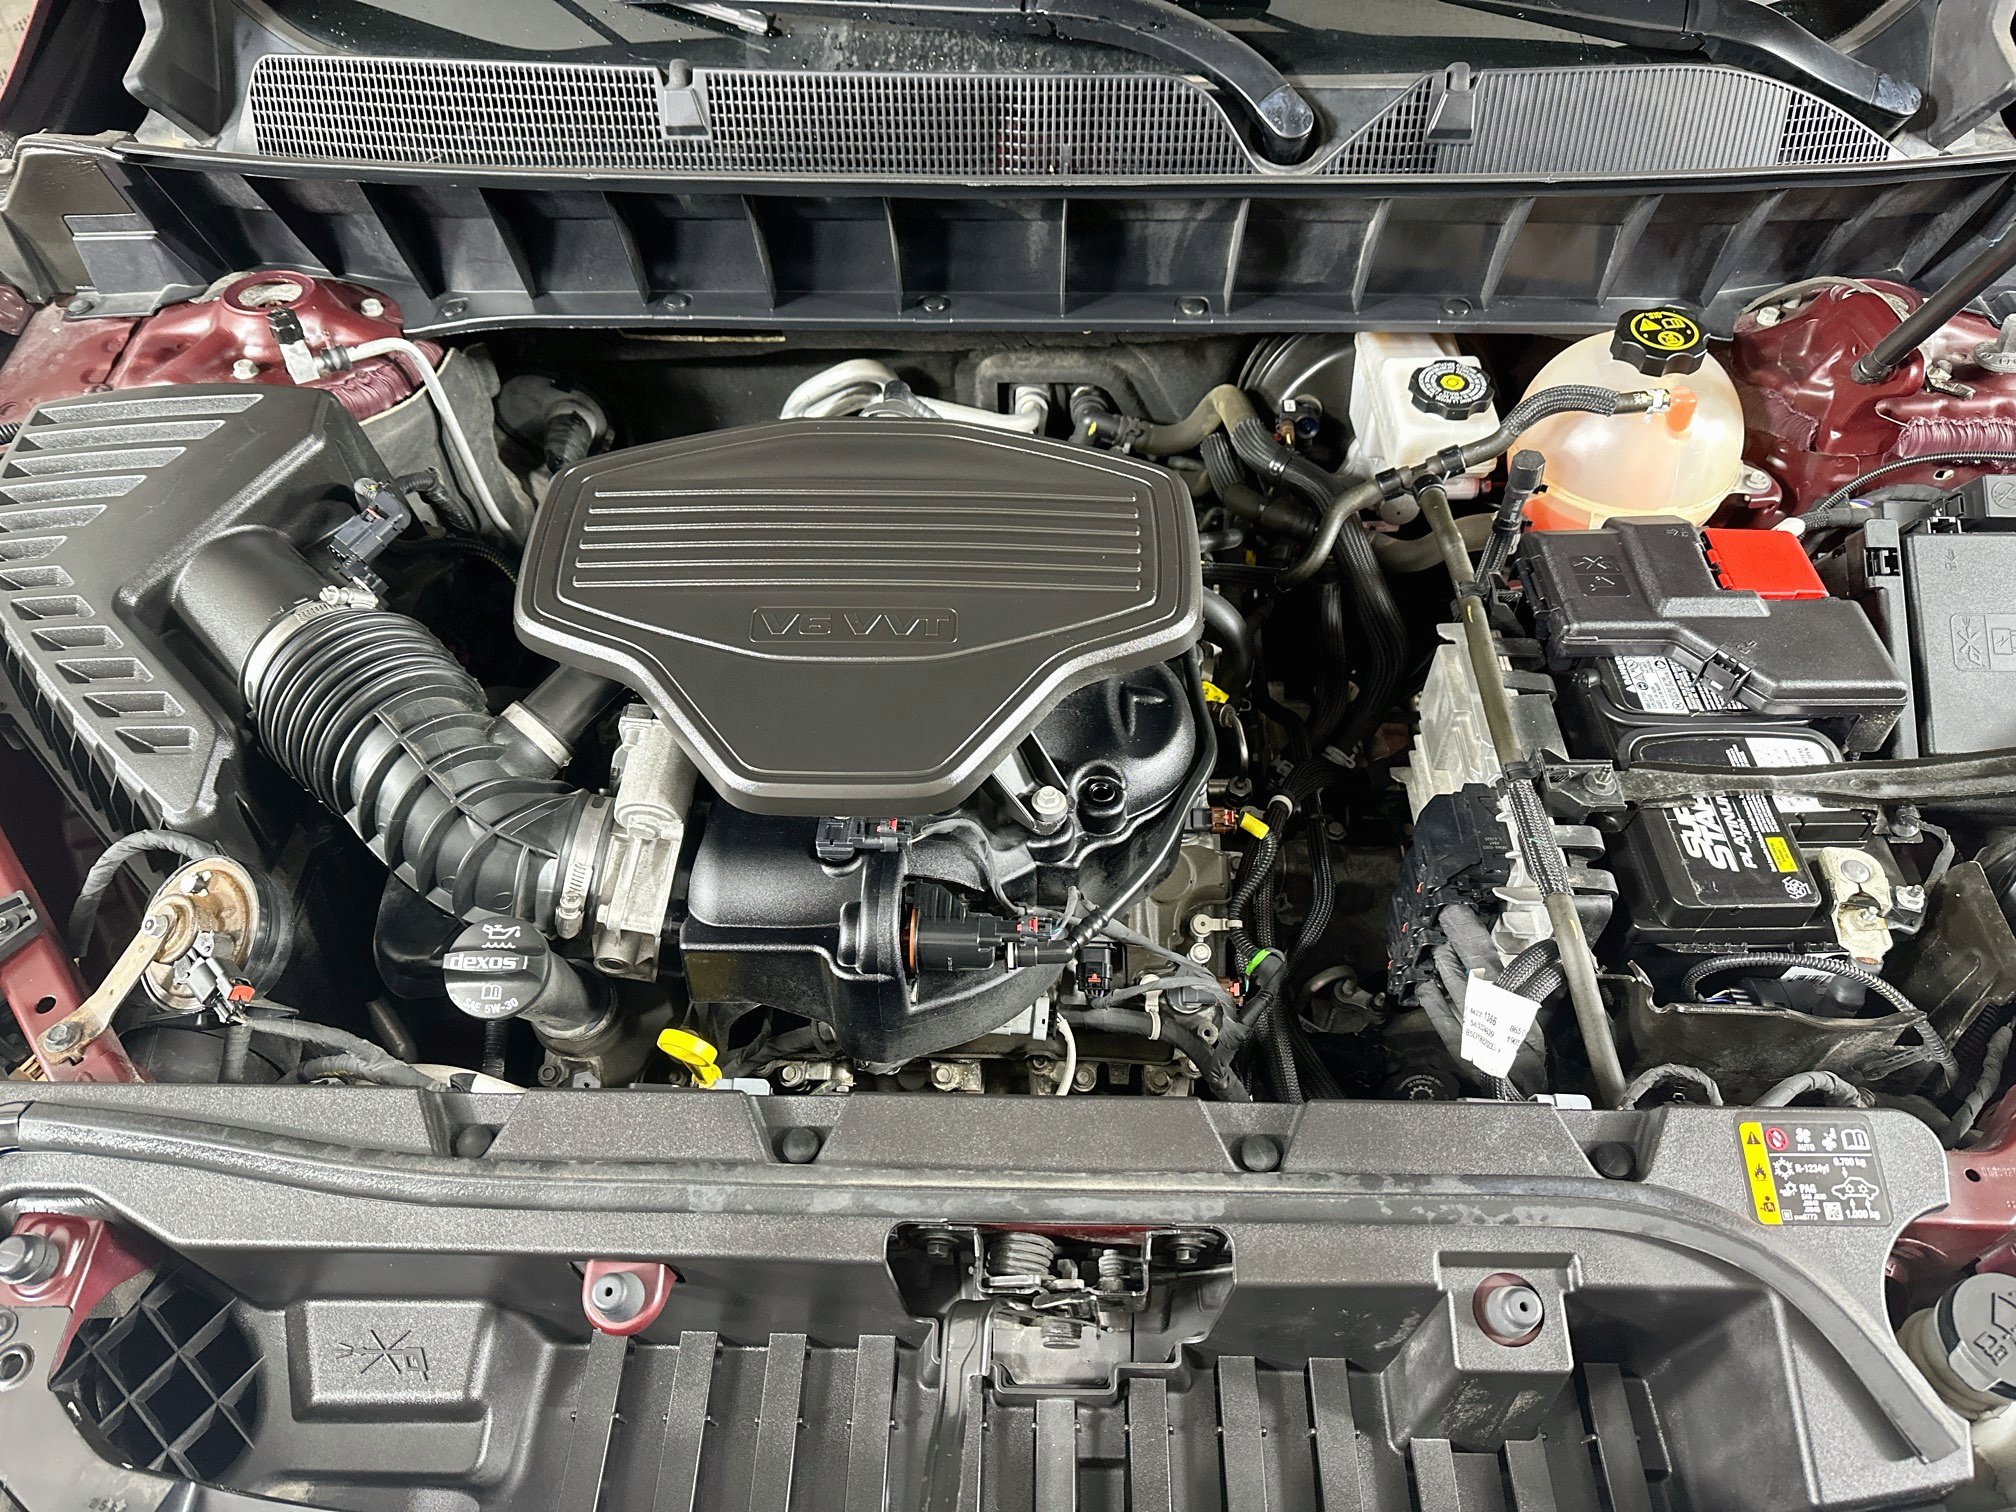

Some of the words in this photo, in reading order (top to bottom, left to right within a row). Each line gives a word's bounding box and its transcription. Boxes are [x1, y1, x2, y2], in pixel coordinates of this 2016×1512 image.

[760, 613, 832, 636] V6
[843, 613, 950, 636] VVT
[1672, 806, 1703, 859] SUP
[1691, 795, 1741, 873] STAR
[449, 952, 517, 970] dexos
[463, 997, 481, 1012] SAE
[484, 997, 519, 1014] 5W-30
[1797, 1143, 1816, 1152] AUTO
